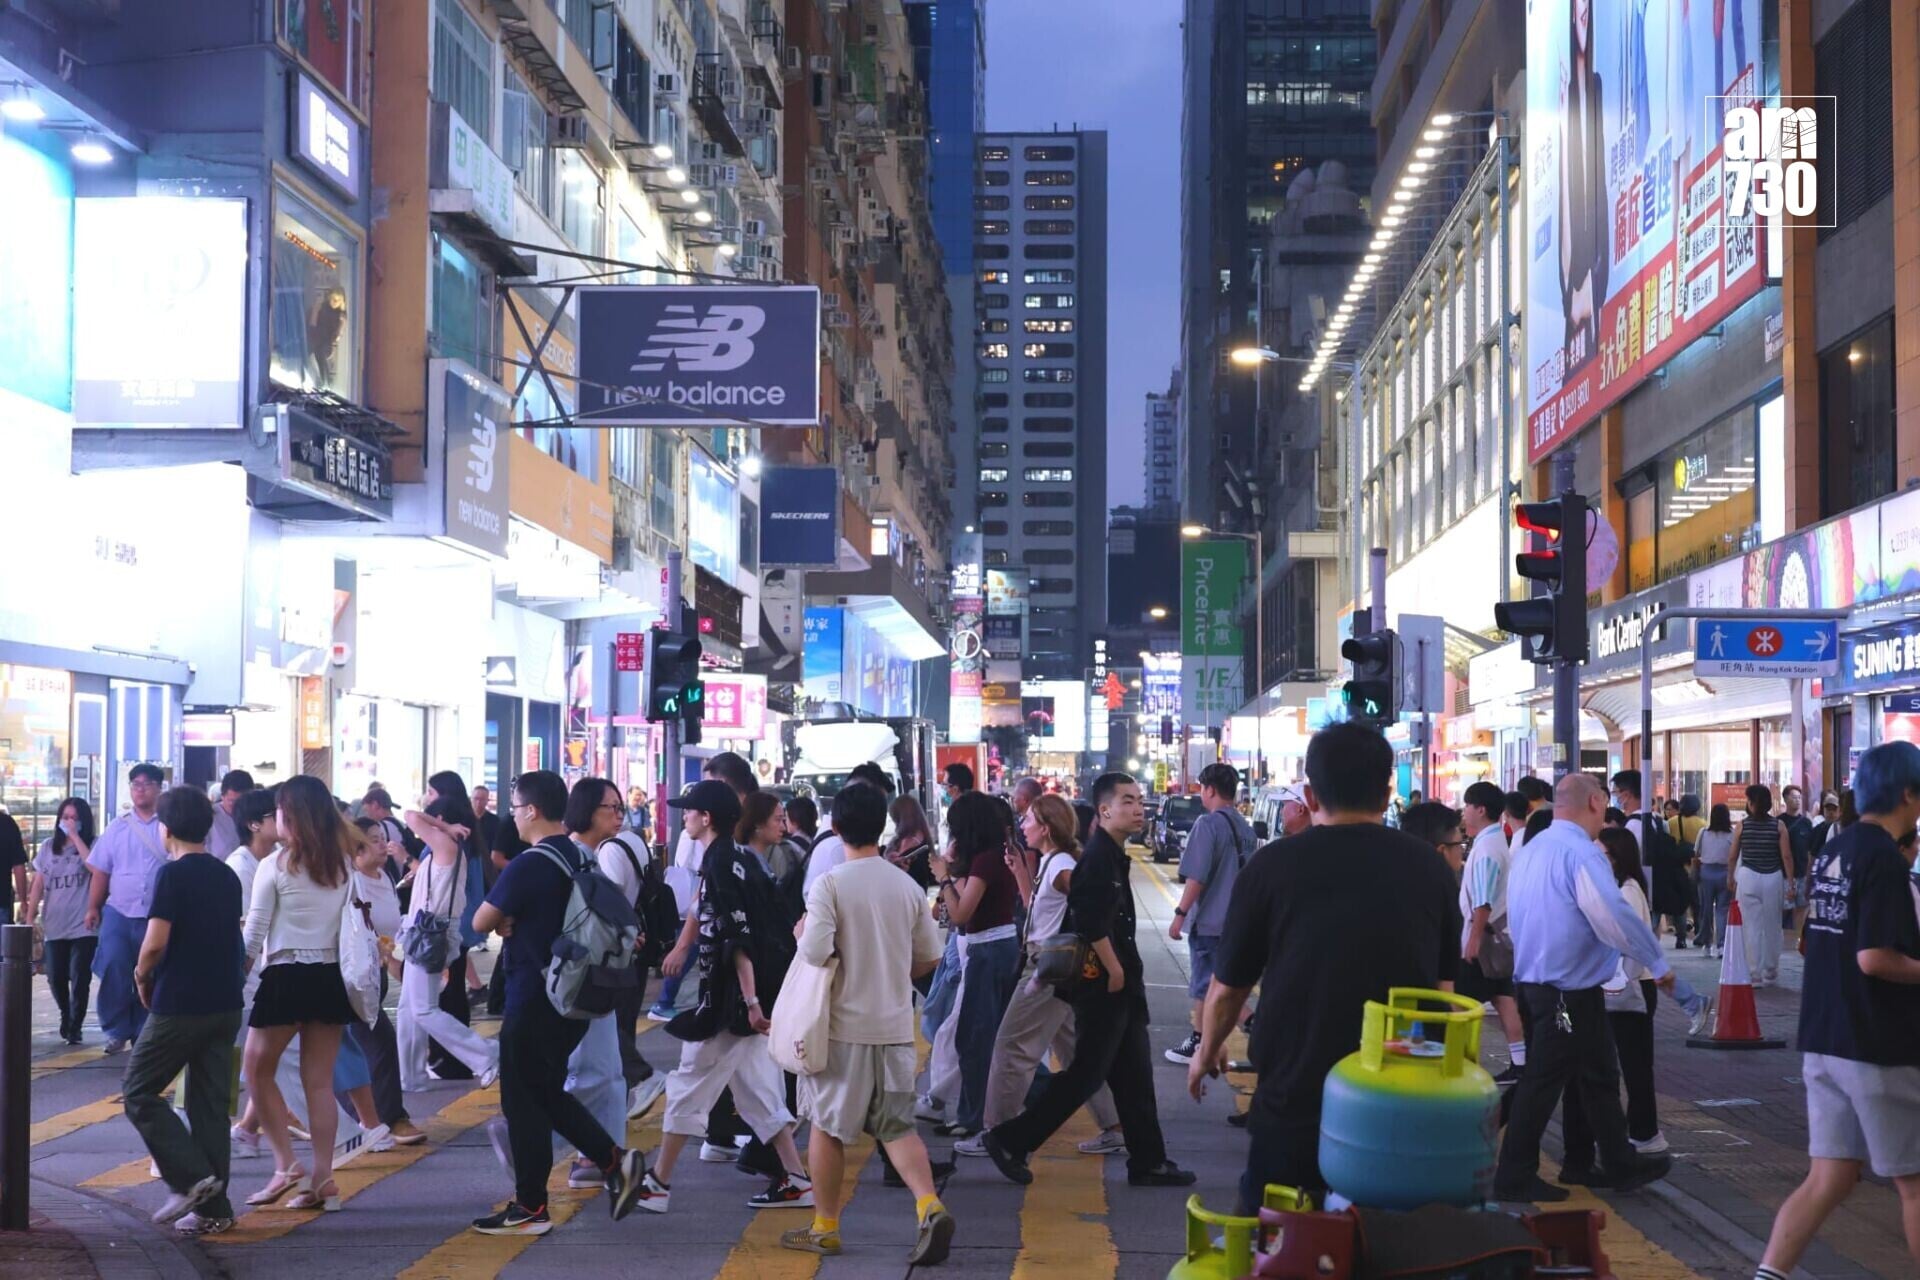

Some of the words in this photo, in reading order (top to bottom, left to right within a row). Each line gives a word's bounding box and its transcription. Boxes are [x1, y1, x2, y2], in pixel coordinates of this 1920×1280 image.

[1613, 136, 1673, 266] 痛症管理
[602, 384, 662, 405] new
[667, 380, 787, 406] balance
[458, 498, 473, 524] new
[473, 501, 500, 535] balance
[770, 511, 830, 520] SKECHERS
[1195, 558, 1214, 645] Pricerite
[1598, 618, 1617, 659] Bank
[1616, 611, 1643, 653] Centre
[1720, 662, 1755, 673] 旺角站
[1758, 665, 1778, 674] Mong
[1779, 666, 1792, 674] Kok
[1793, 666, 1818, 674] Station
[1854, 637, 1902, 680] SUNING
[1195, 667, 1230, 689] 1/F
